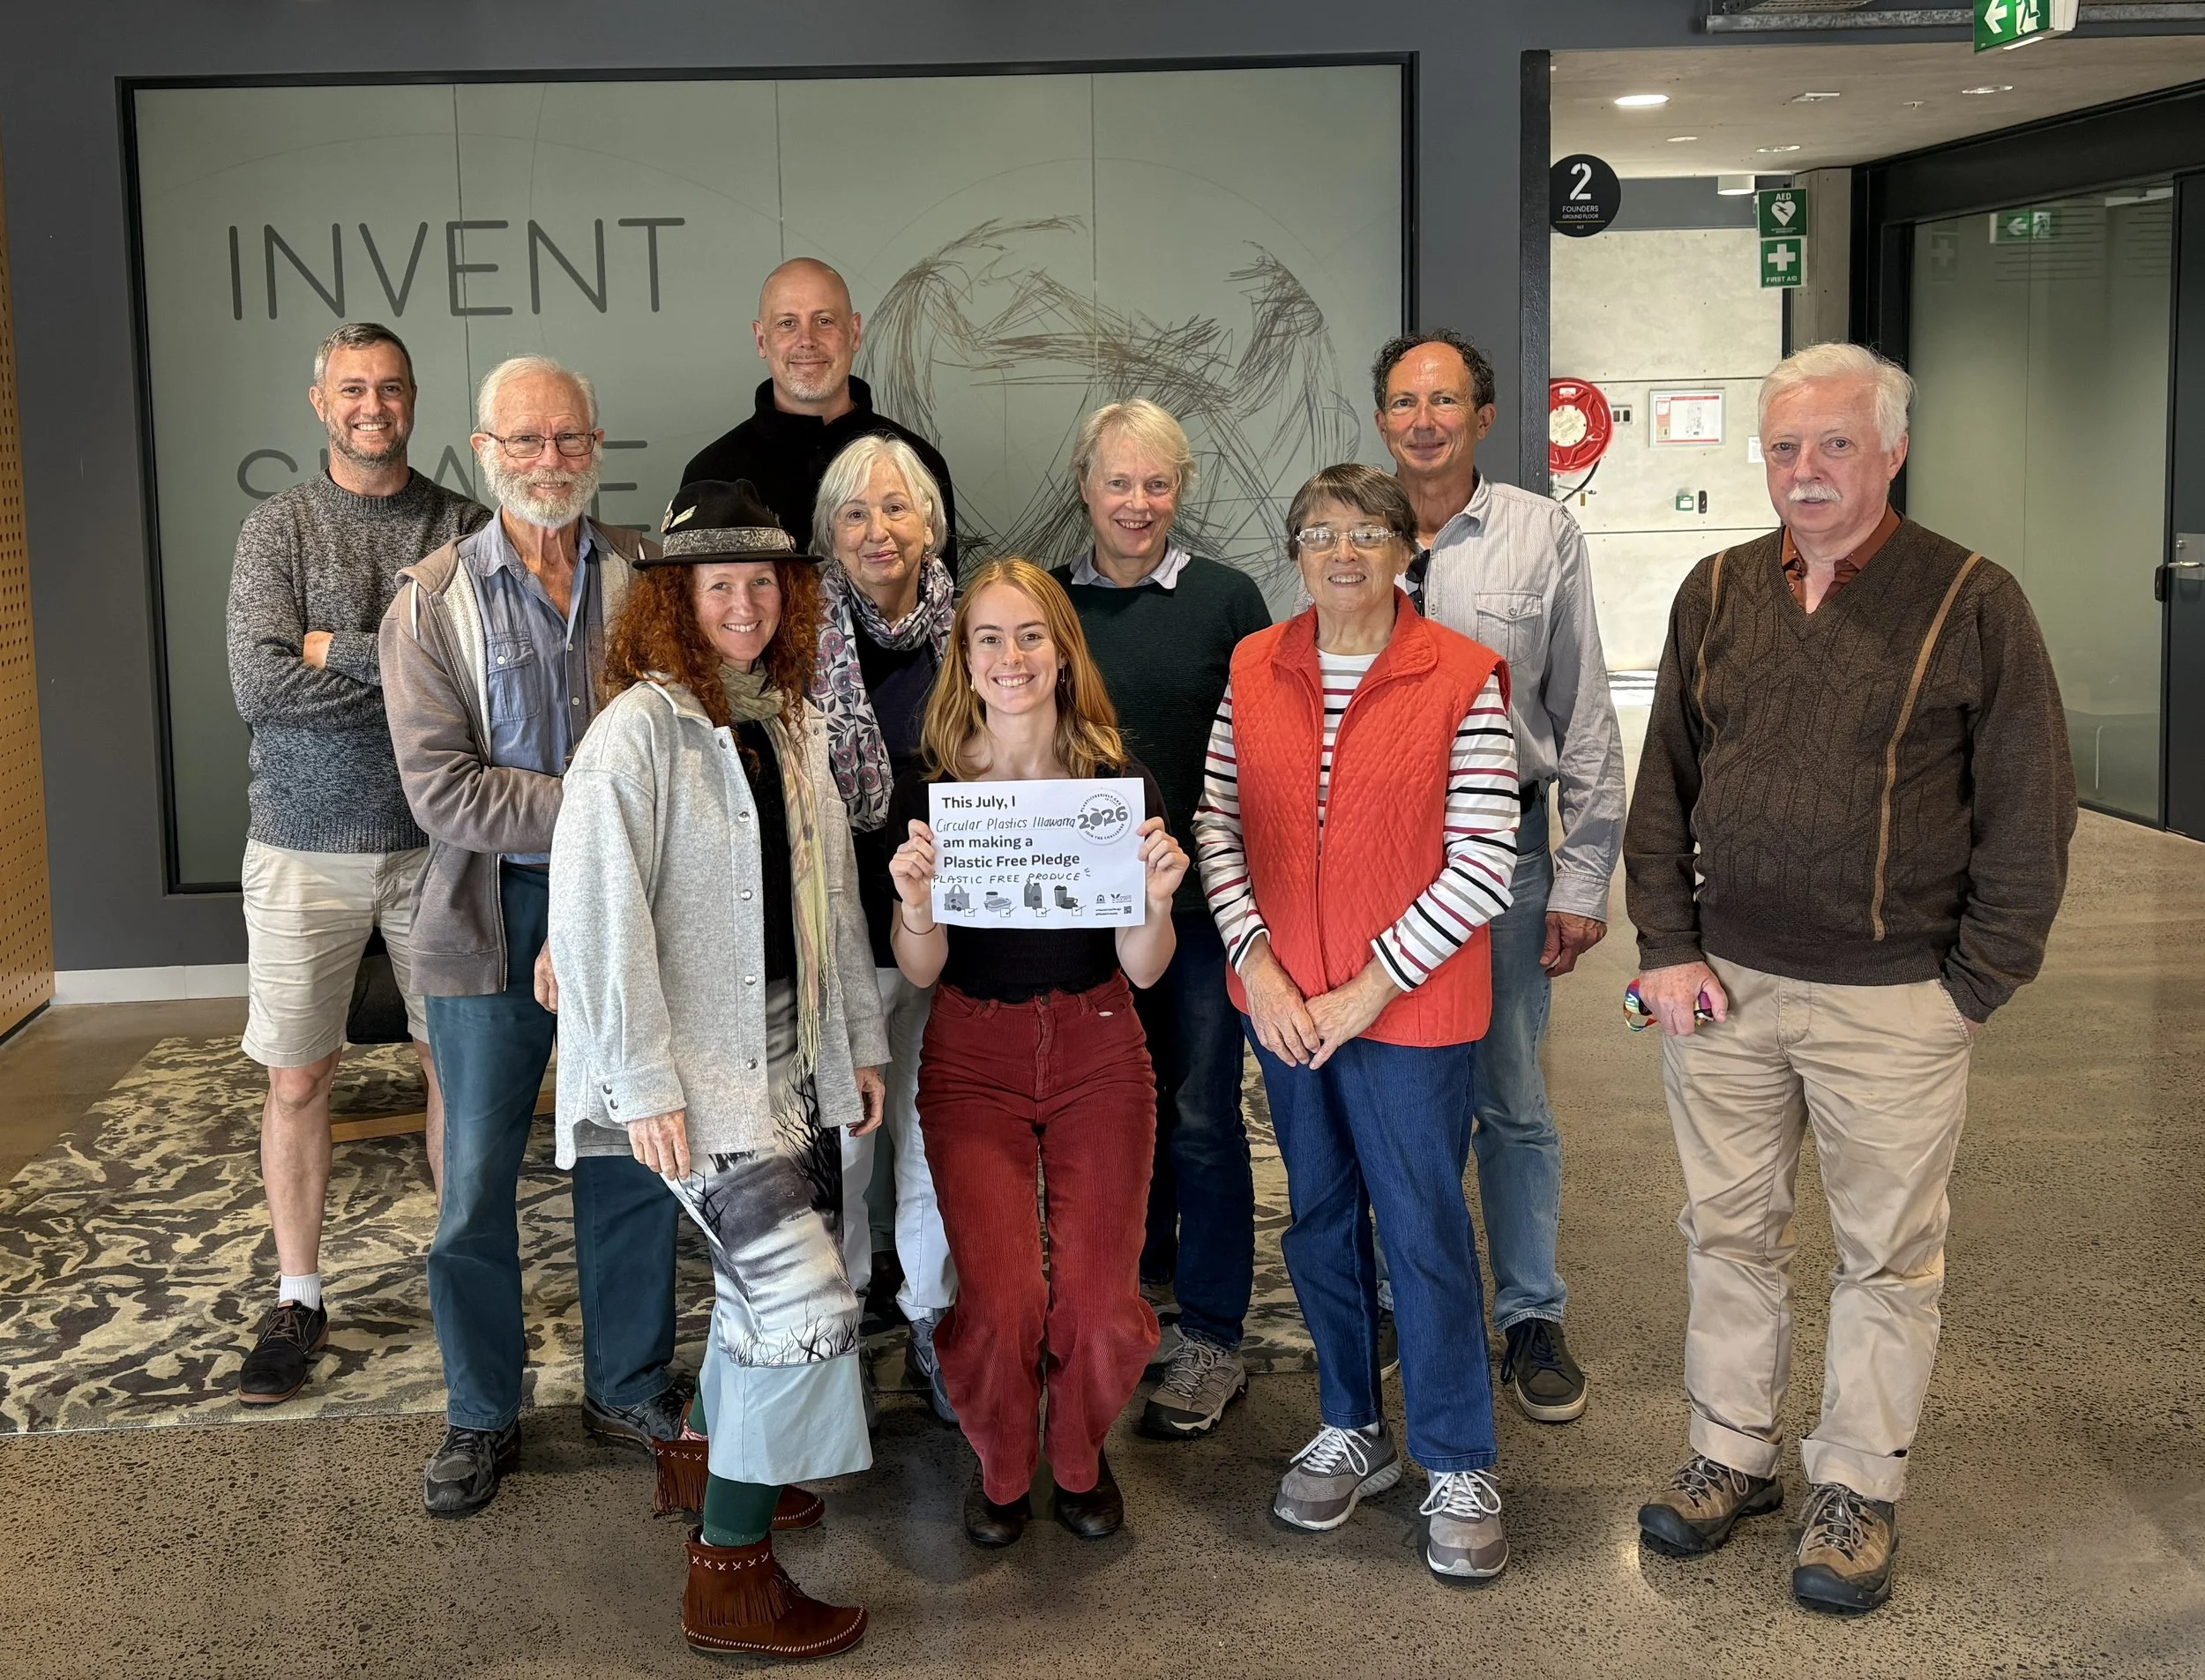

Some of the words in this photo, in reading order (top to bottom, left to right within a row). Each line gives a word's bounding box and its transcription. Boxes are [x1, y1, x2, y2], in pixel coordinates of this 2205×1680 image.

[1570, 162, 1592, 201] 2
[1775, 192, 1792, 201] AED
[228, 217, 685, 320] INVENT
[941, 796, 973, 809] This
[975, 795, 1008, 810] July,
[936, 818, 983, 833] Circular
[987, 818, 1028, 831] Plastics
[1077, 806, 1128, 830] 2026
[943, 839, 965, 848] am
[968, 835, 1022, 850] making
[1025, 837, 1034, 847] a
[944, 855, 992, 868] Plastic
[997, 855, 1028, 867] Free
[1031, 854, 1080, 867] Pledge
[933, 874, 983, 884] PLASTIC
[990, 875, 1020, 884] FREE
[1028, 872, 1080, 881] PRODUCE
